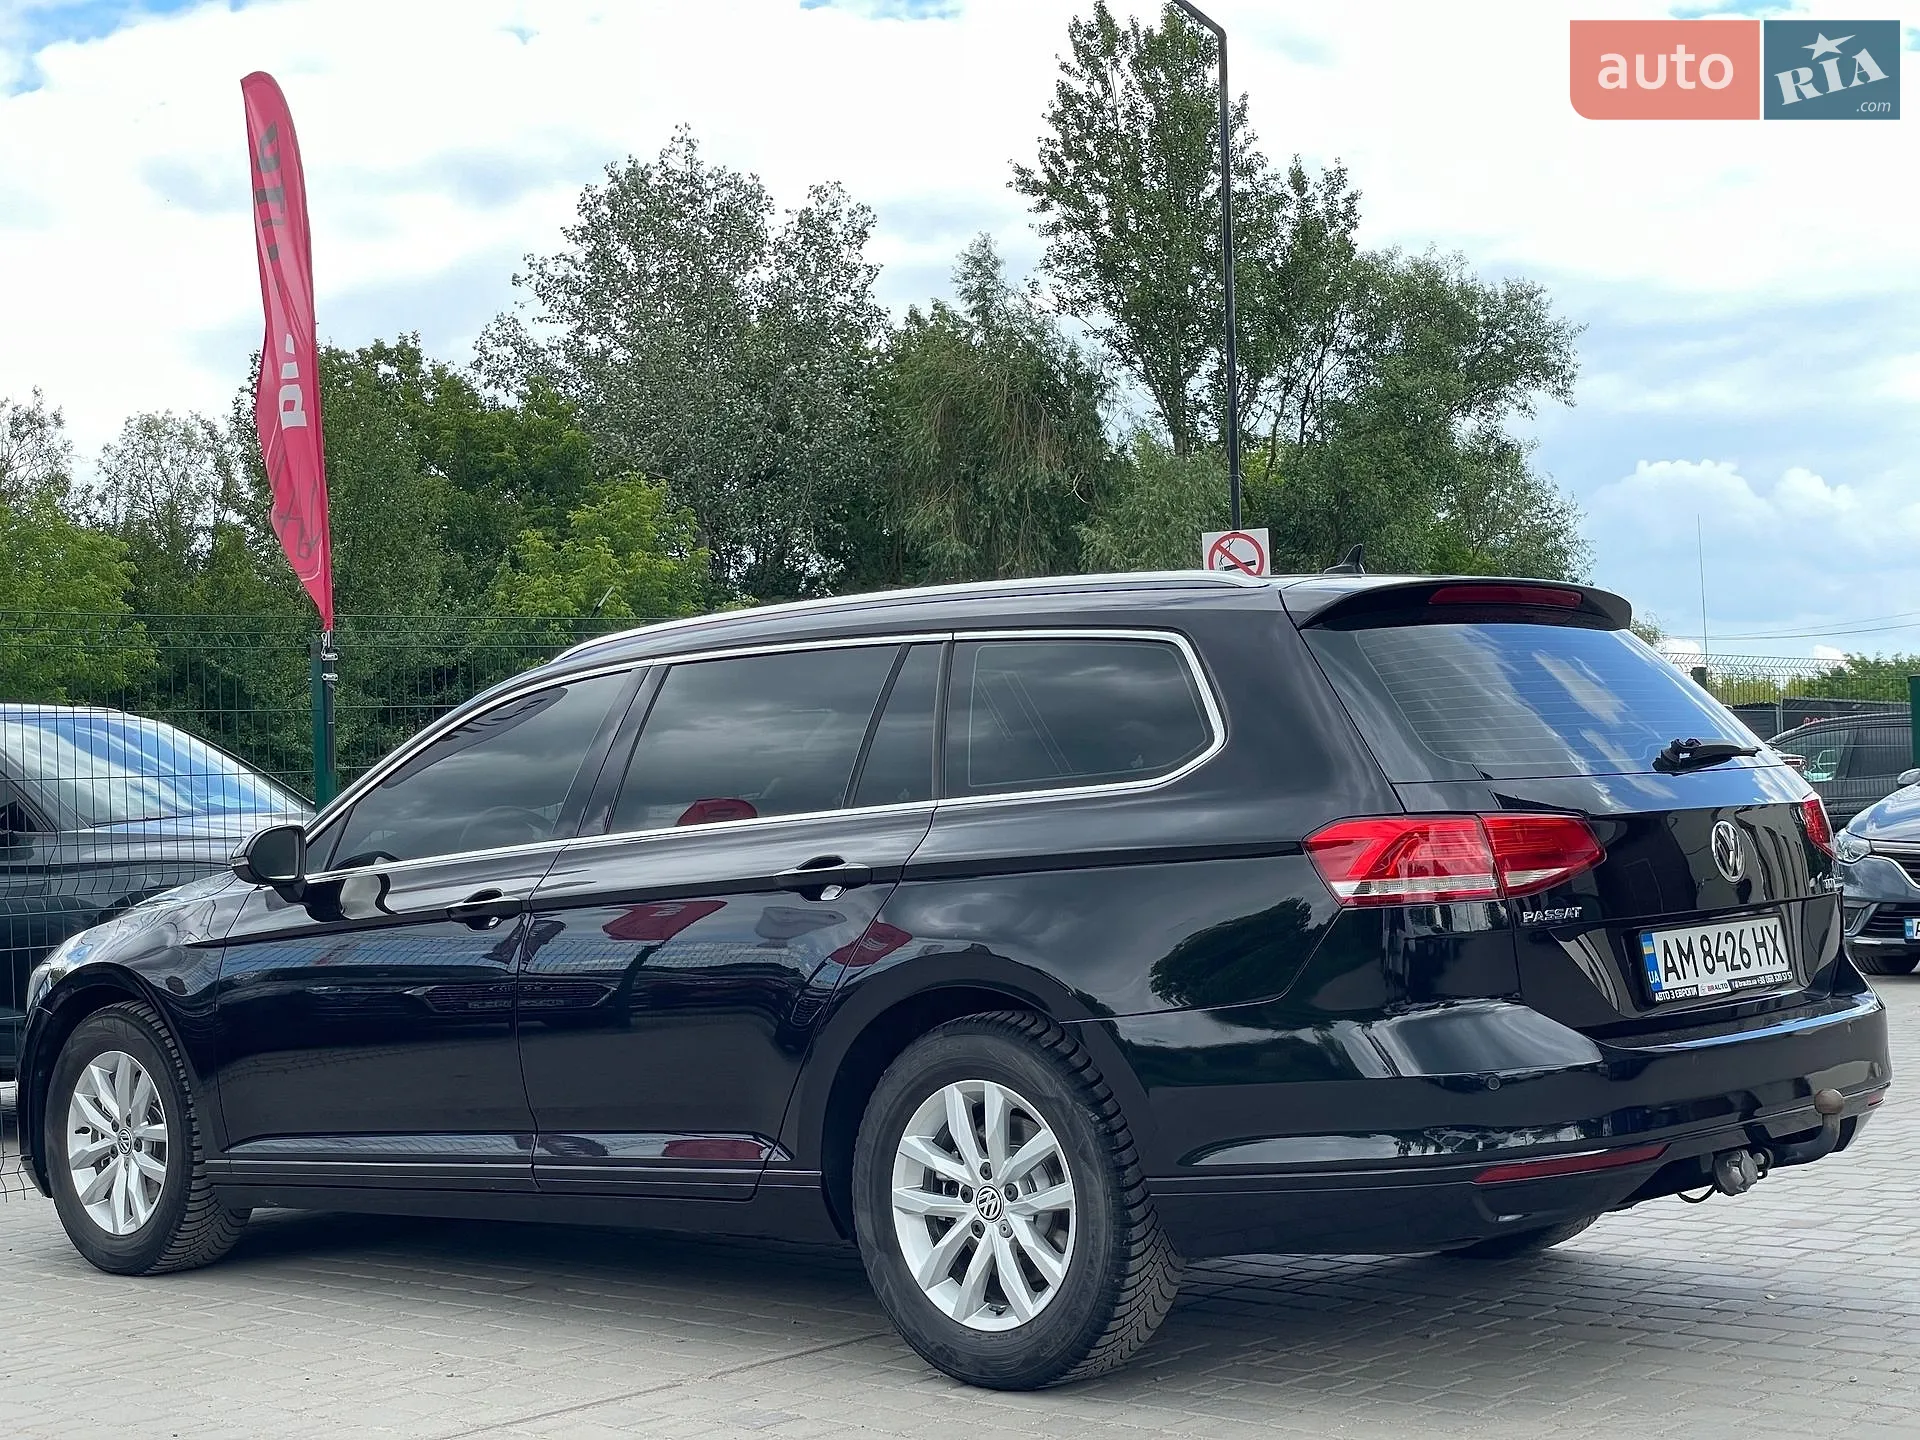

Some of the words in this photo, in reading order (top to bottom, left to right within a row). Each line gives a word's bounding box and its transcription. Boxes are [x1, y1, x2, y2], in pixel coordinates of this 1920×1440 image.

[1522, 906, 1583, 923] PASSAT
[1663, 936, 1700, 983] AM
[1700, 929, 1752, 975] 8426
[1752, 924, 1785, 967] HX
[1648, 971, 1661, 984] UA
